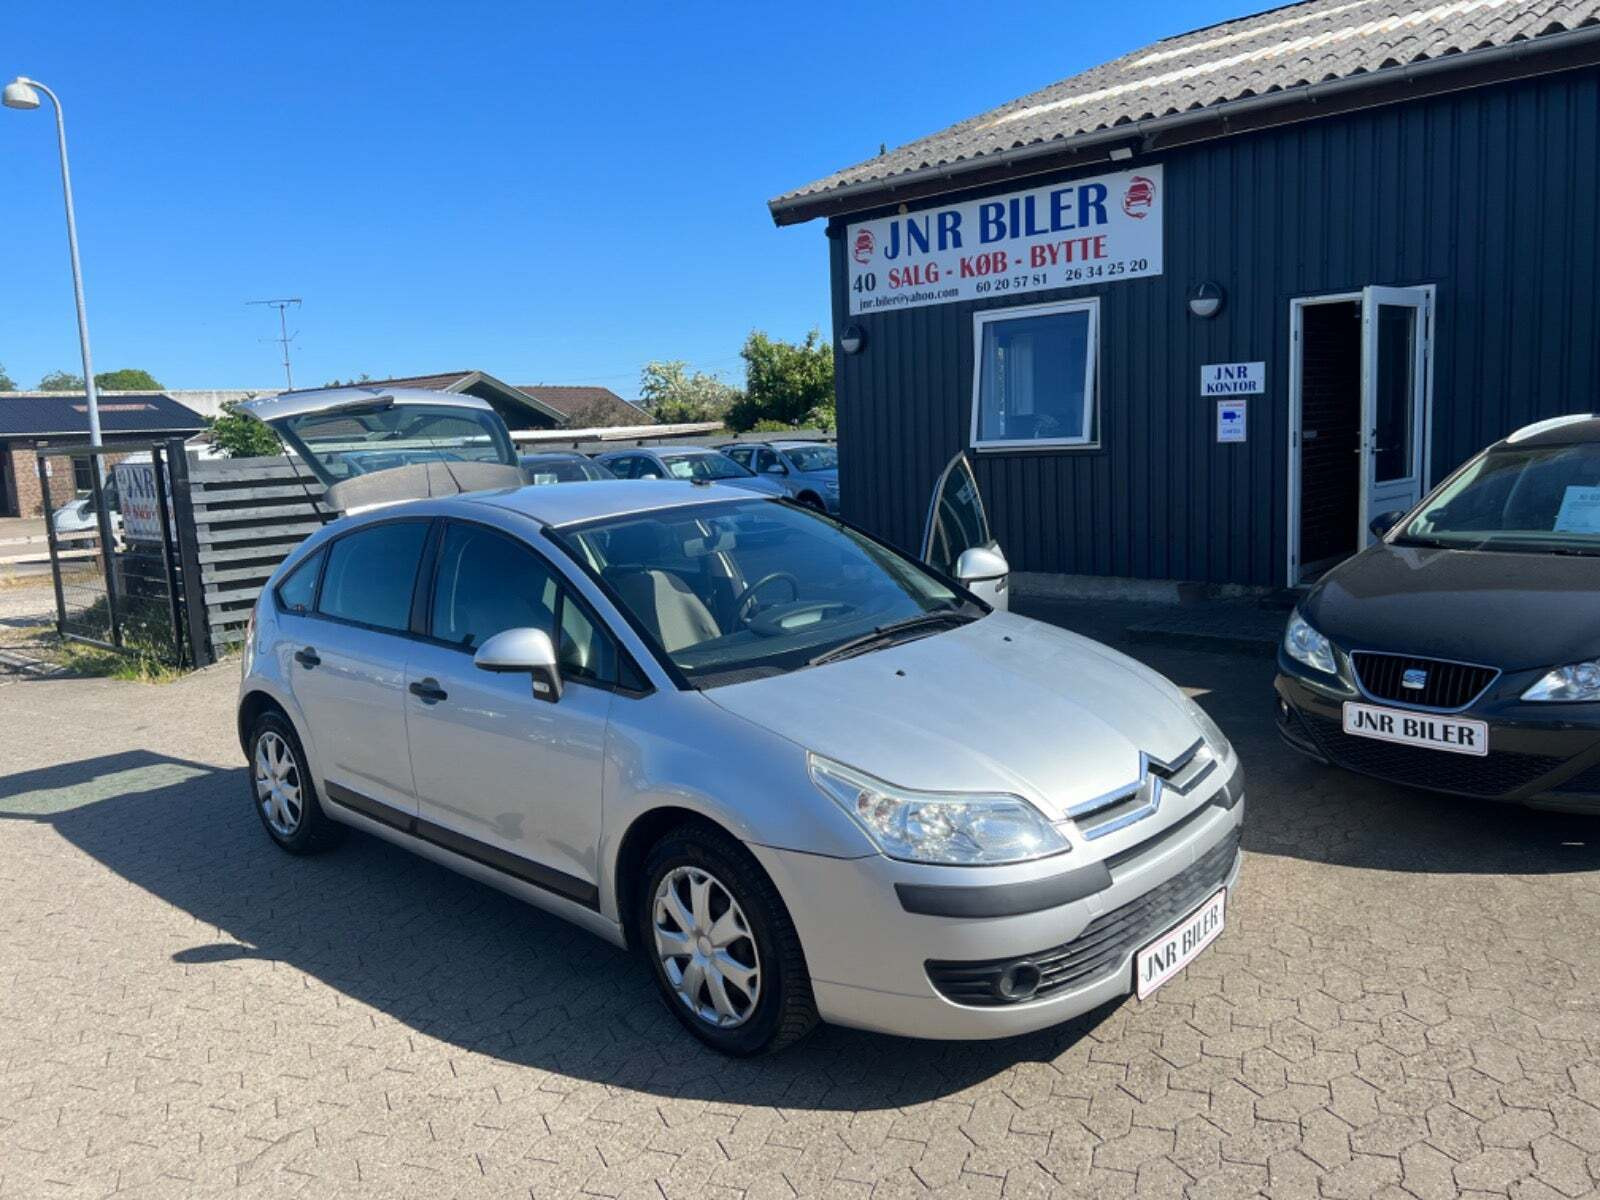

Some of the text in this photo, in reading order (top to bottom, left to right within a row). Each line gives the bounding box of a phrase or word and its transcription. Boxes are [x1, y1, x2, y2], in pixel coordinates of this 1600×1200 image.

[884, 182, 1108, 260] JNR BILER
[853, 272, 876, 293] 40
[888, 262, 939, 289] SALG
[960, 251, 1007, 278] KØB
[1031, 235, 1108, 268] BYTTE
[859, 258, 1148, 311] jnr.biler@yahoo.com 60 20 57 81 26 34 25 20
[1207, 380, 1257, 393] KONTOR
[1214, 365, 1248, 380] JNR
[1354, 710, 1475, 746] JNR BILER
[1142, 904, 1218, 982] JNR BILER
